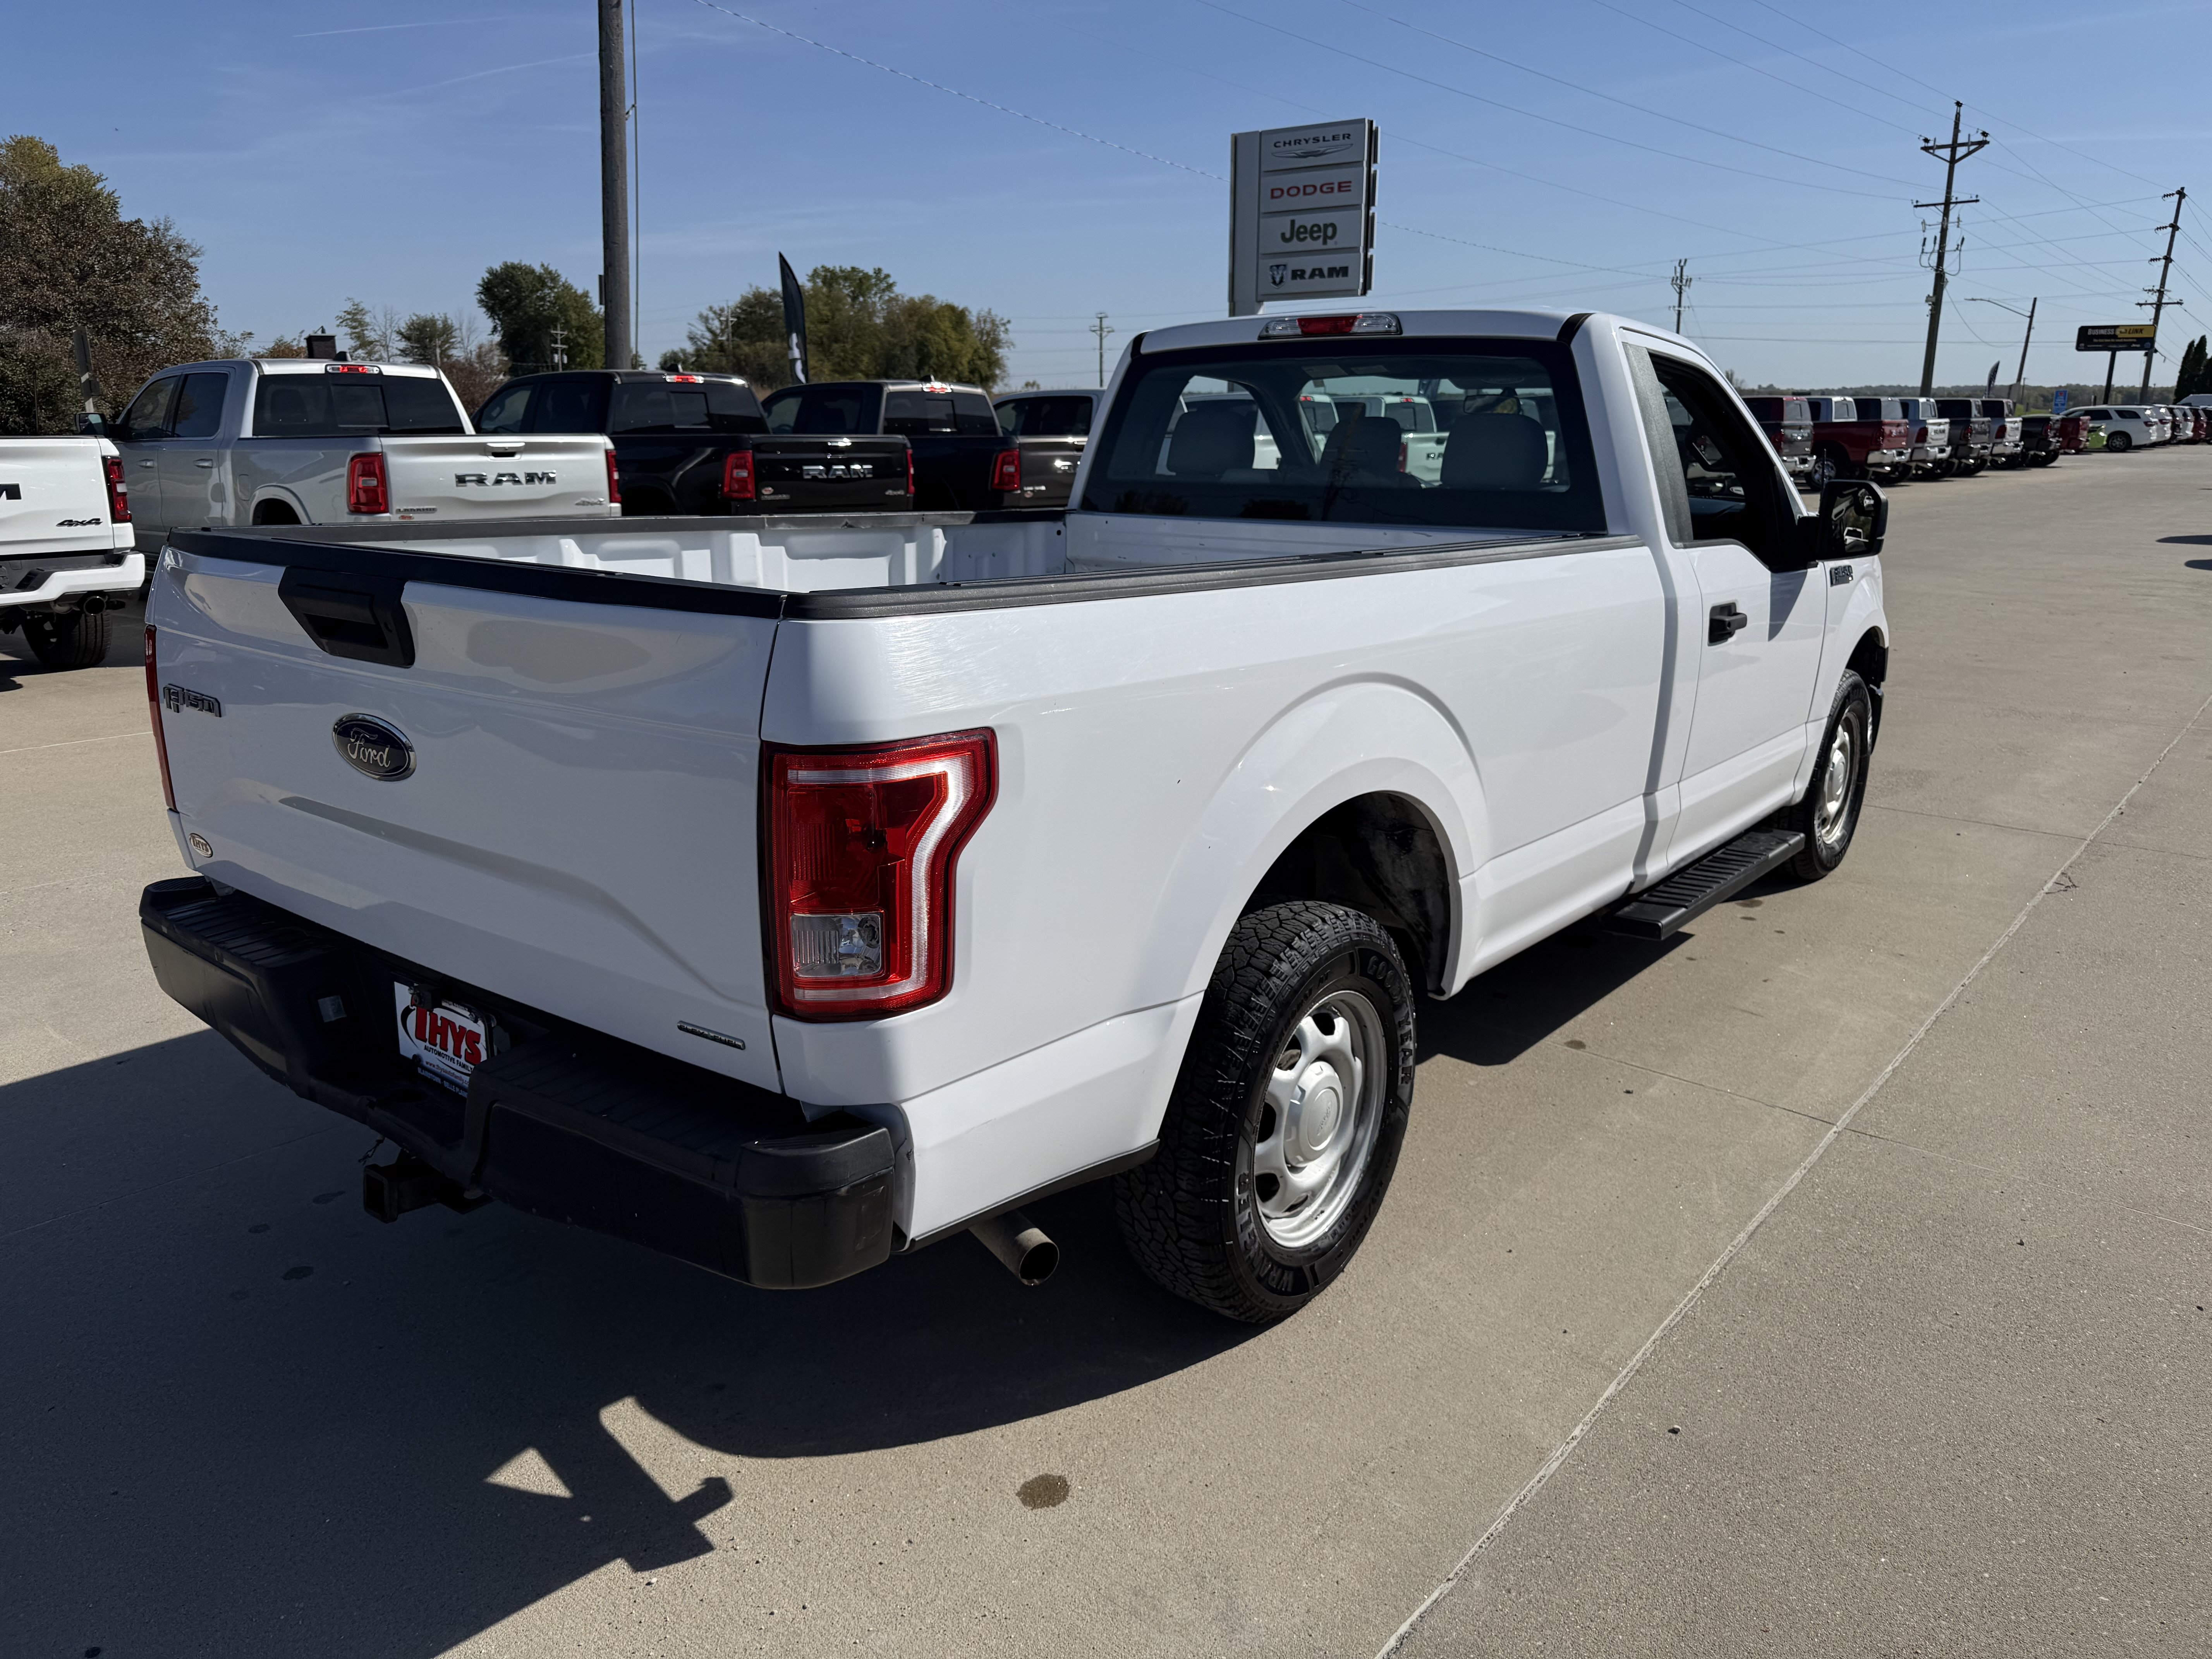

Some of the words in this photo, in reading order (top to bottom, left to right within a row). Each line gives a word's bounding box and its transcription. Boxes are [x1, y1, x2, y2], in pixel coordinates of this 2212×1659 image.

[1273, 133, 1352, 148] CHRYSLER
[1270, 180, 1352, 199] DODGE
[1280, 219, 1337, 245] Jeep
[1291, 266, 1349, 281] RAM
[455, 470, 556, 487] RAM
[802, 465, 873, 479] RAM
[347, 727, 391, 768] Ford
[190, 834, 210, 853] THYS
[410, 992, 482, 1065] THYS
[1367, 955, 1413, 1085] GOODYEAR
[424, 1045, 456, 1064] AUTOMOTIVE
[456, 1060, 473, 1072] FAMILY
[1237, 1172, 1294, 1292] WRANGLER
